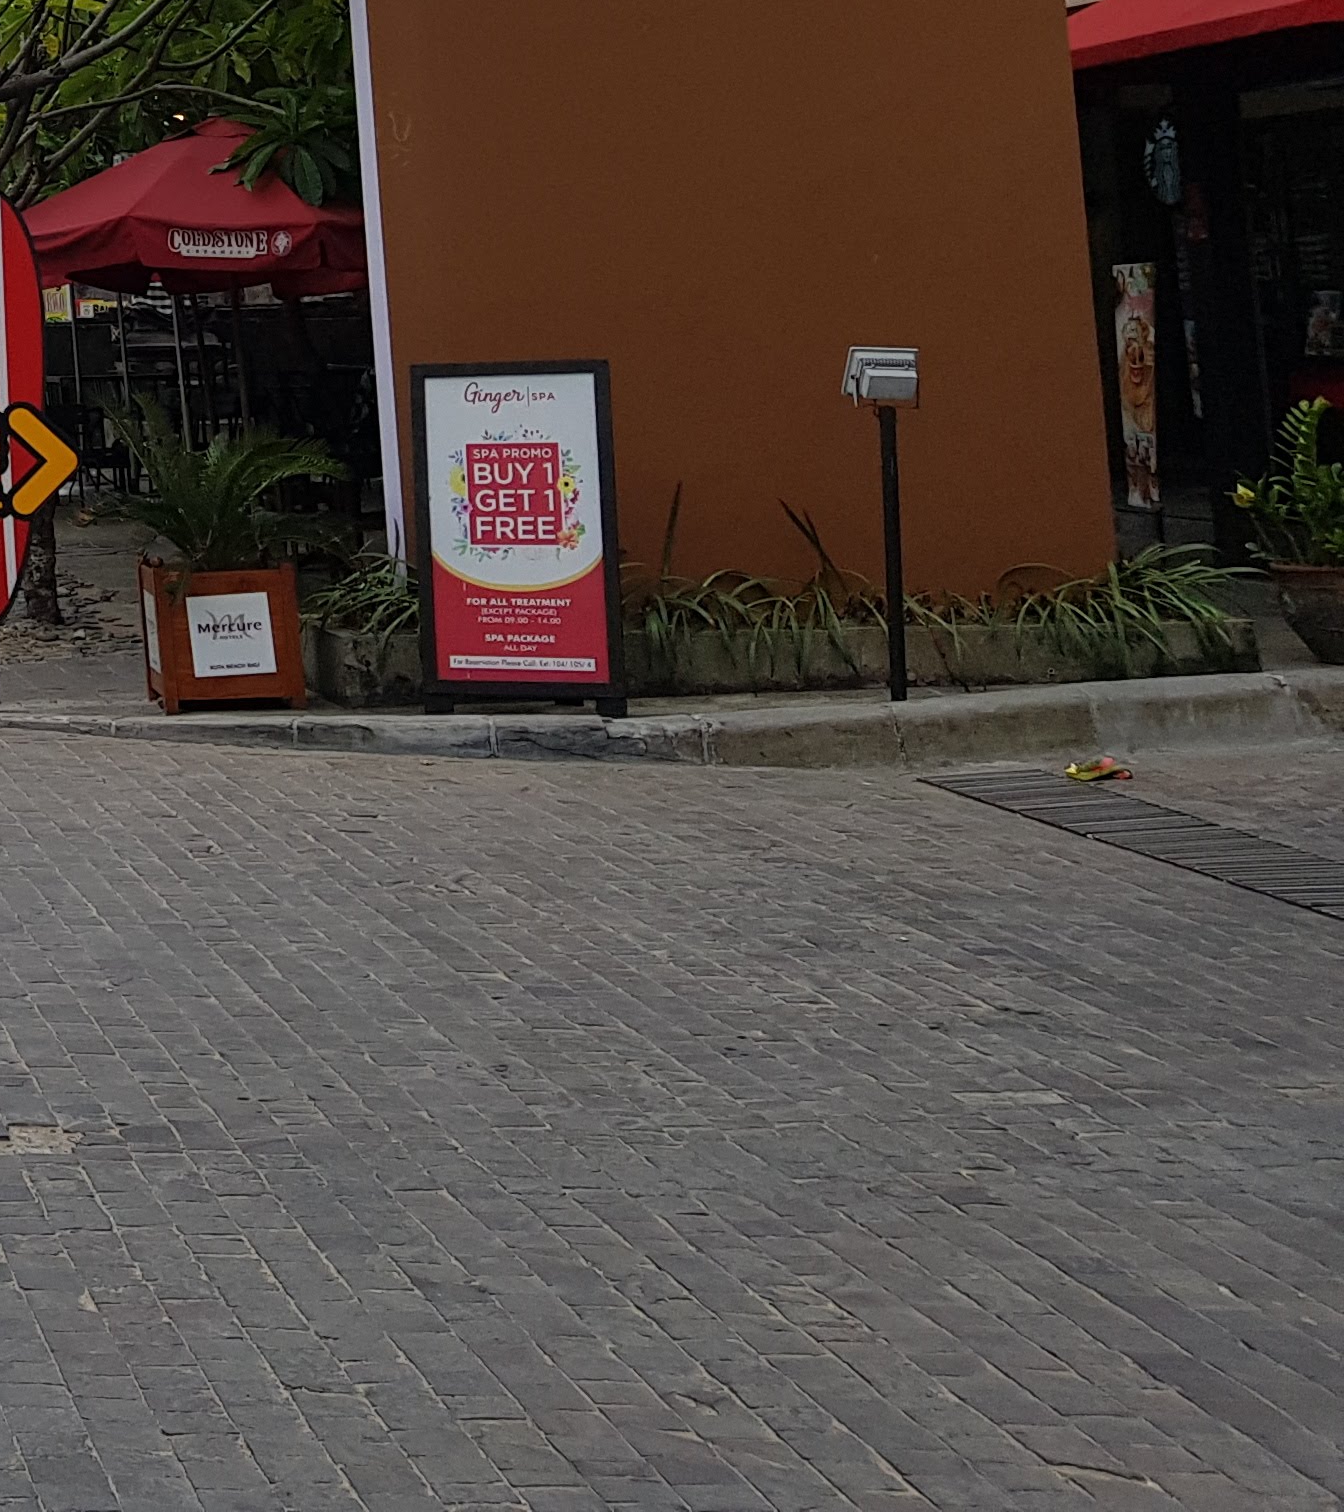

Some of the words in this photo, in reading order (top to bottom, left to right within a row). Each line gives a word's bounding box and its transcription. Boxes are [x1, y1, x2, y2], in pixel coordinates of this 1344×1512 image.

[464, 381, 525, 414] Ginger
[531, 392, 556, 401] SPA
[472, 448, 499, 459] SPA
[502, 447, 553, 459] PROMO
[473, 462, 535, 485] BUY
[542, 462, 554, 485] 1
[475, 489, 536, 512] GET
[543, 489, 555, 512] 1
[475, 516, 557, 540] FREE
[466, 597, 487, 606] FOR
[489, 597, 508, 606] ALL
[511, 598, 572, 607] TREATMENT
[197, 621, 262, 634] Mercure
[484, 634, 504, 642] SPA
[507, 634, 556, 643] PACKAGE
